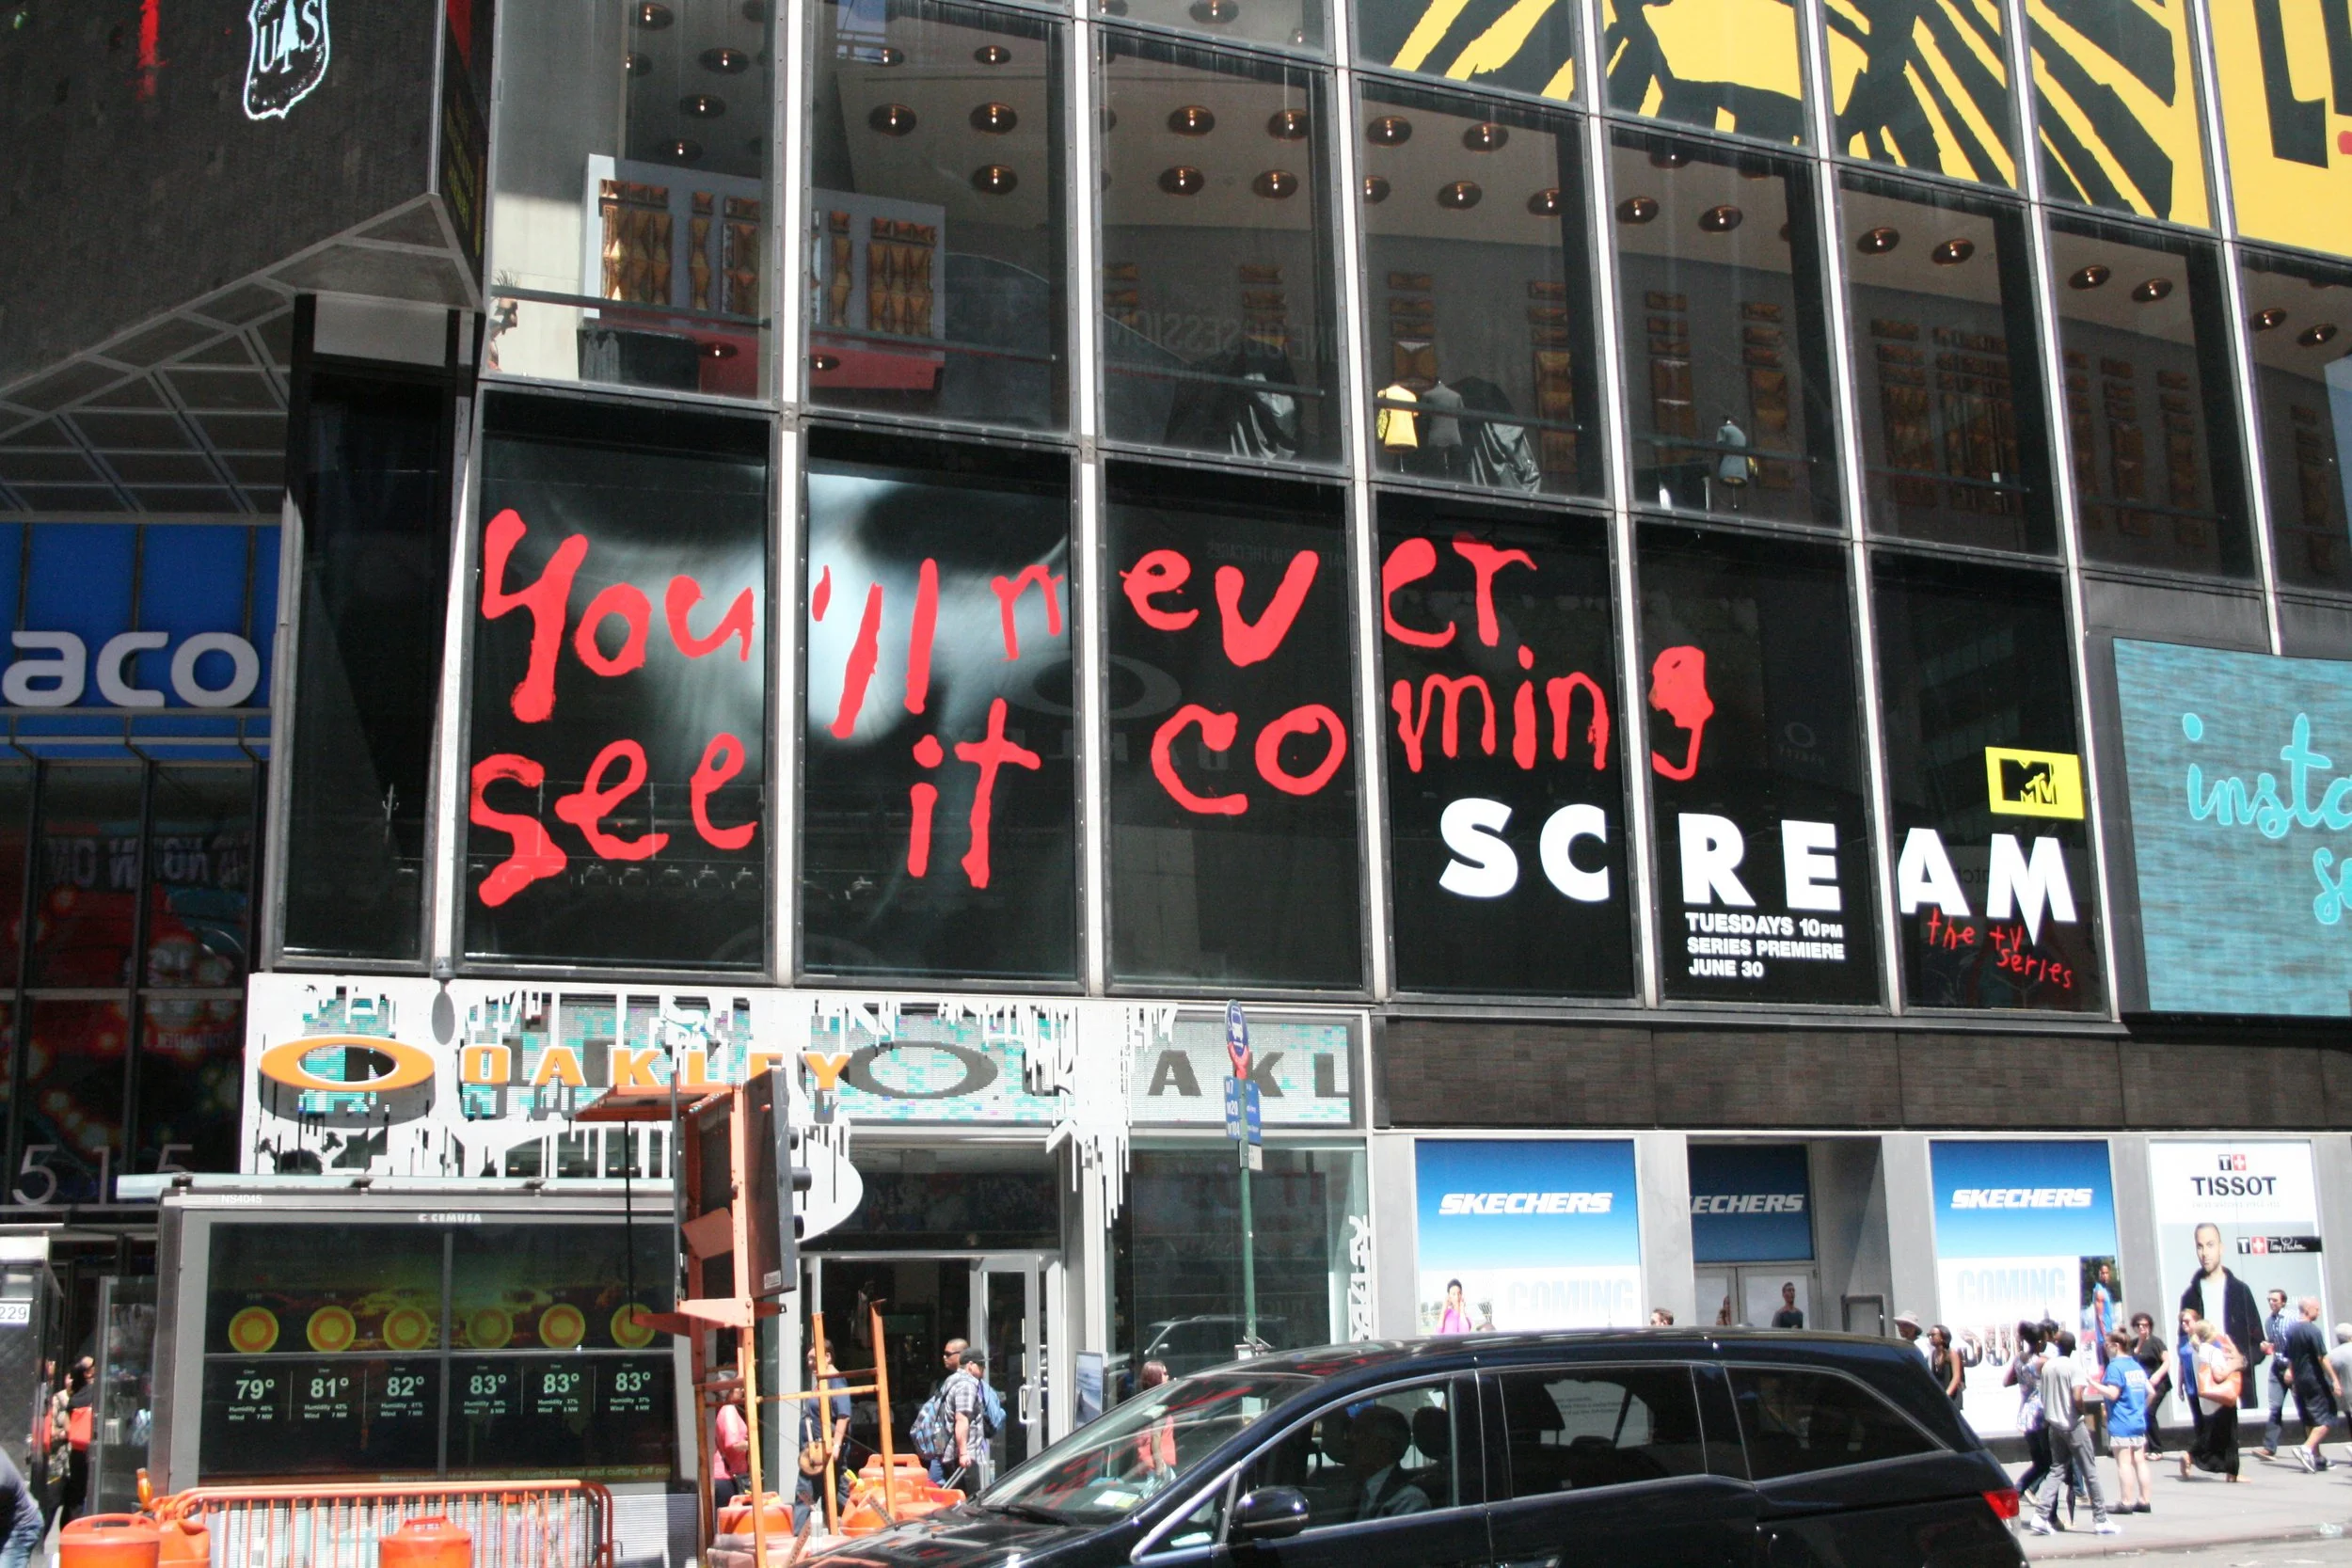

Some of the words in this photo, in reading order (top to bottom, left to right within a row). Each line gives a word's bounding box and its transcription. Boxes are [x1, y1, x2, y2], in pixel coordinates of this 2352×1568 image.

[991, 536, 1539, 667] never
[908, 698, 1041, 888] it
[1152, 645, 1714, 815] coming
[1999, 758, 2058, 805] MTV
[1439, 799, 2077, 946] SCREAM
[1685, 912, 1794, 936] TUESDAYS
[1928, 908, 1975, 950] the
[1687, 937, 1752, 956] SERIES
[1756, 940, 1845, 959] PREMIERE
[1689, 958, 1737, 977] JUNE
[1741, 960, 1764, 977] 30
[1996, 948, 2072, 989] series
[1951, 1188, 2092, 1210] SKECHERS
[2190, 1177, 2277, 1196] TISSOT
[431, 1212, 482, 1224] CEMUSA
[1438, 1193, 1613, 1214] SKECHERS
[1690, 1194, 1804, 1214] ECHERS
[1507, 1278, 1634, 1316] COMING
[1957, 1267, 2066, 1305] COMING
